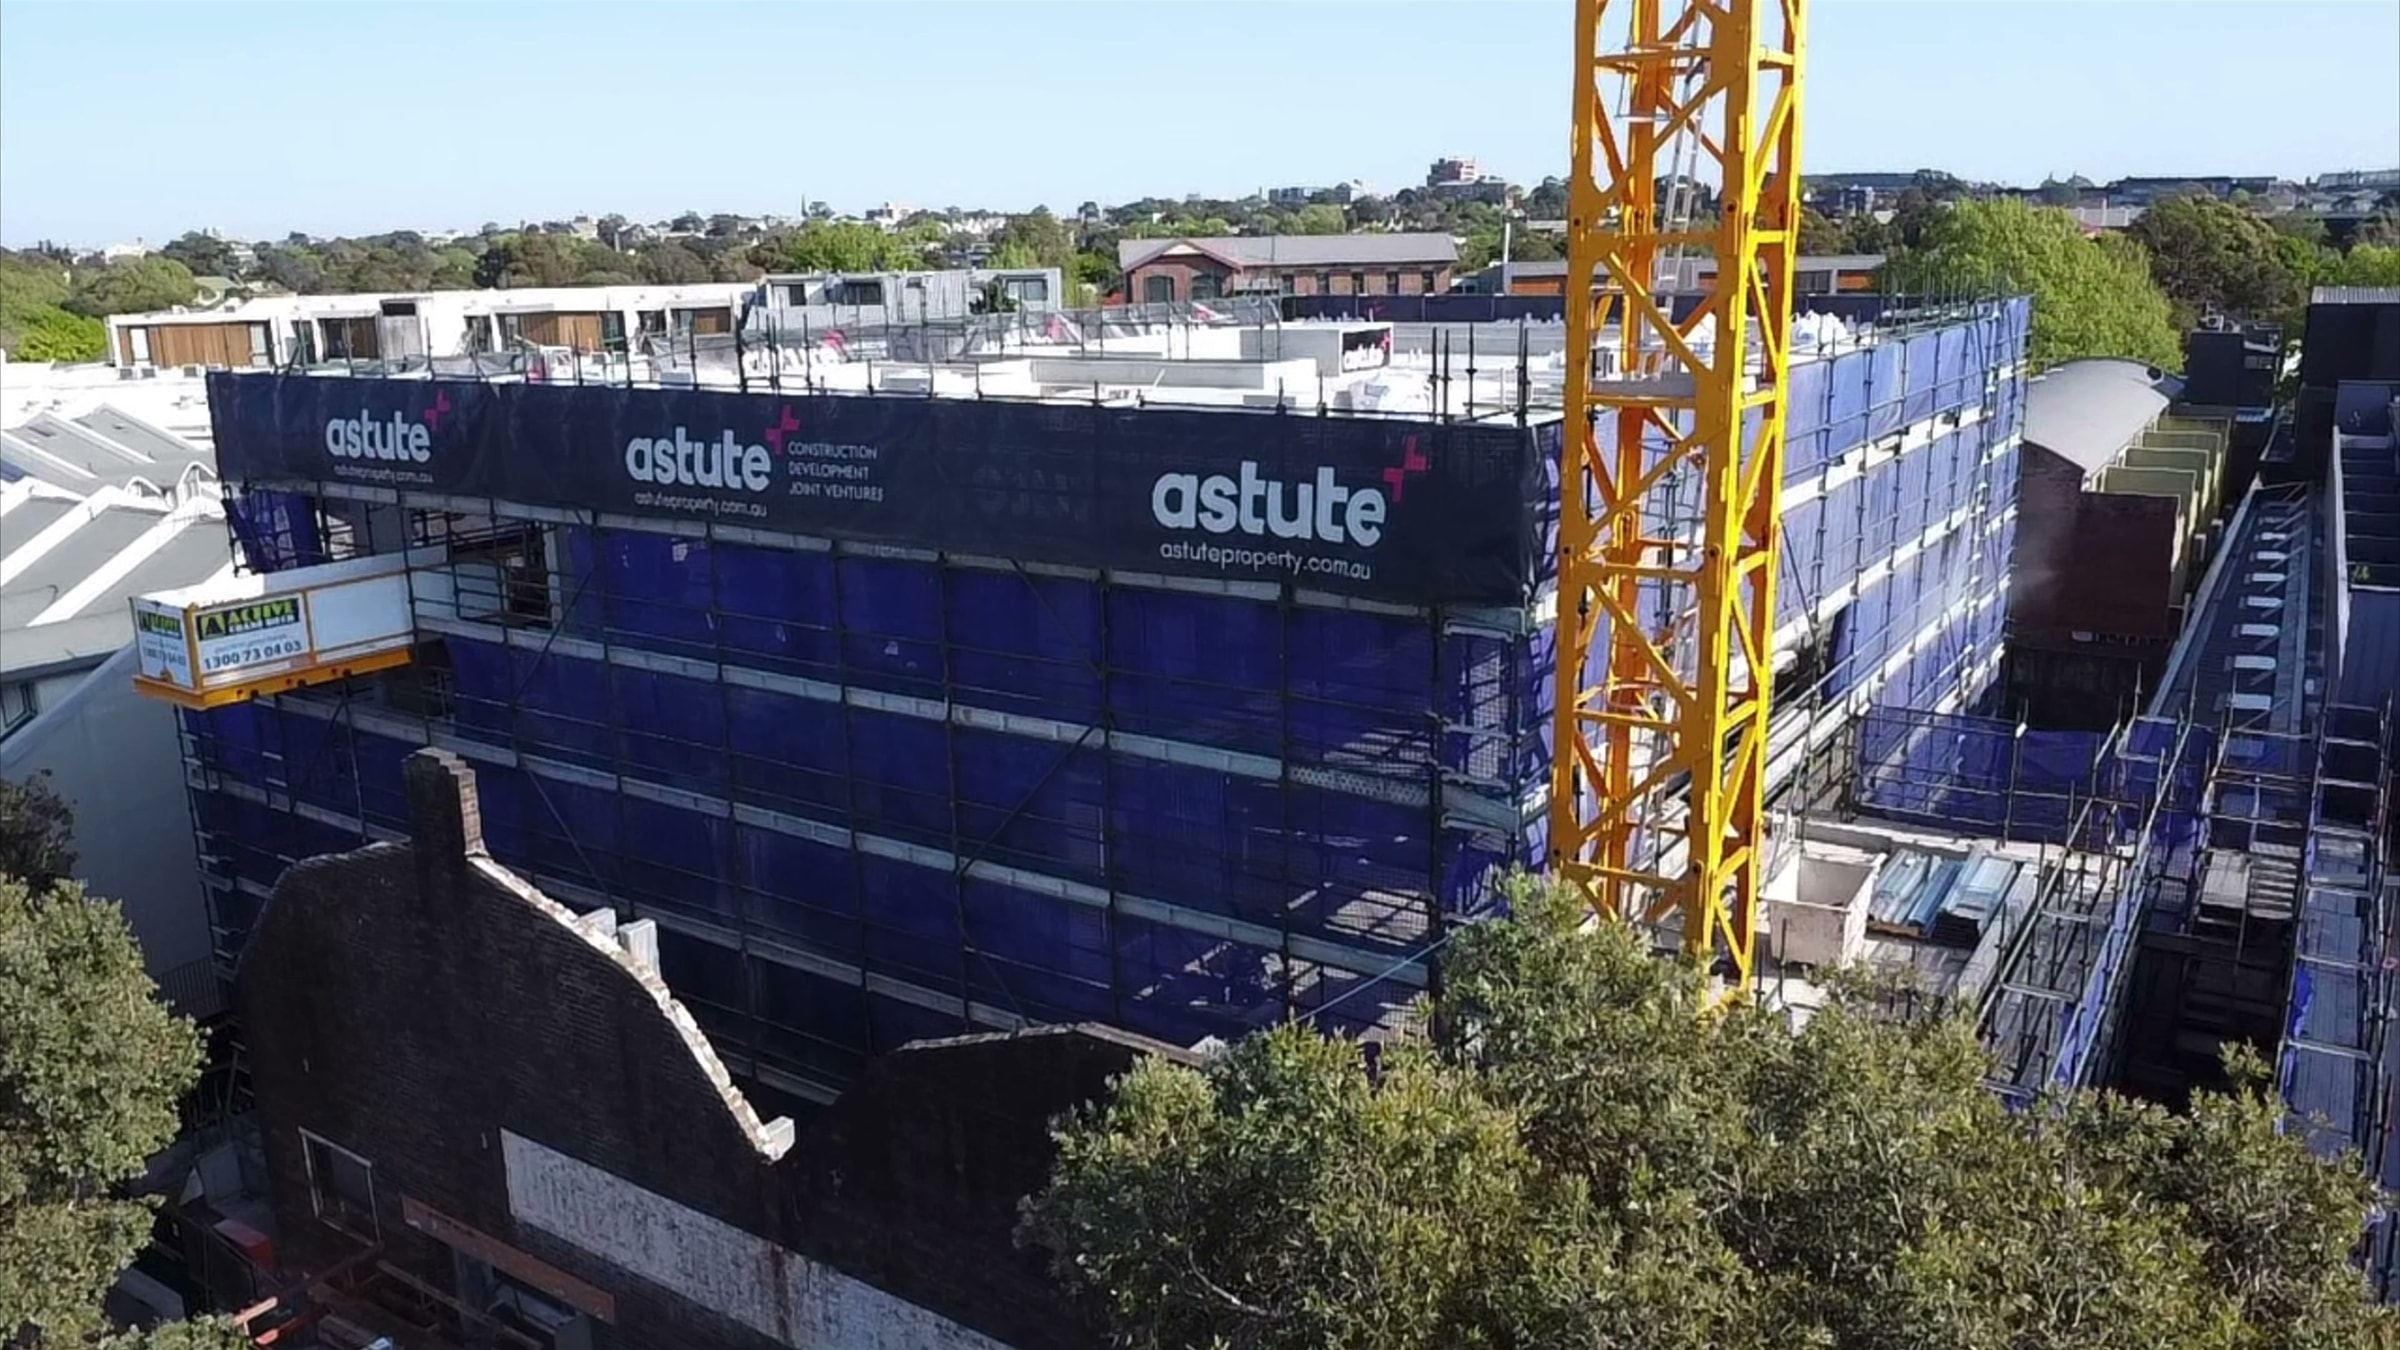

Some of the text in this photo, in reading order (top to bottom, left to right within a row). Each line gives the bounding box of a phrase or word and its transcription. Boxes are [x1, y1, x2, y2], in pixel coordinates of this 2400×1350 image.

[326, 408, 431, 463] astute
[788, 441, 878, 459] CONSTRUCTION
[625, 426, 771, 492] astute
[788, 460, 869, 480] DEVELOPMENT
[789, 481, 883, 502] JOINT VENTURES
[1152, 460, 1386, 547] astute
[1160, 541, 1371, 580] astuteproperty.com.au
[204, 652, 240, 670] 1300
[242, 647, 261, 662] 73
[284, 640, 303, 654] 03
